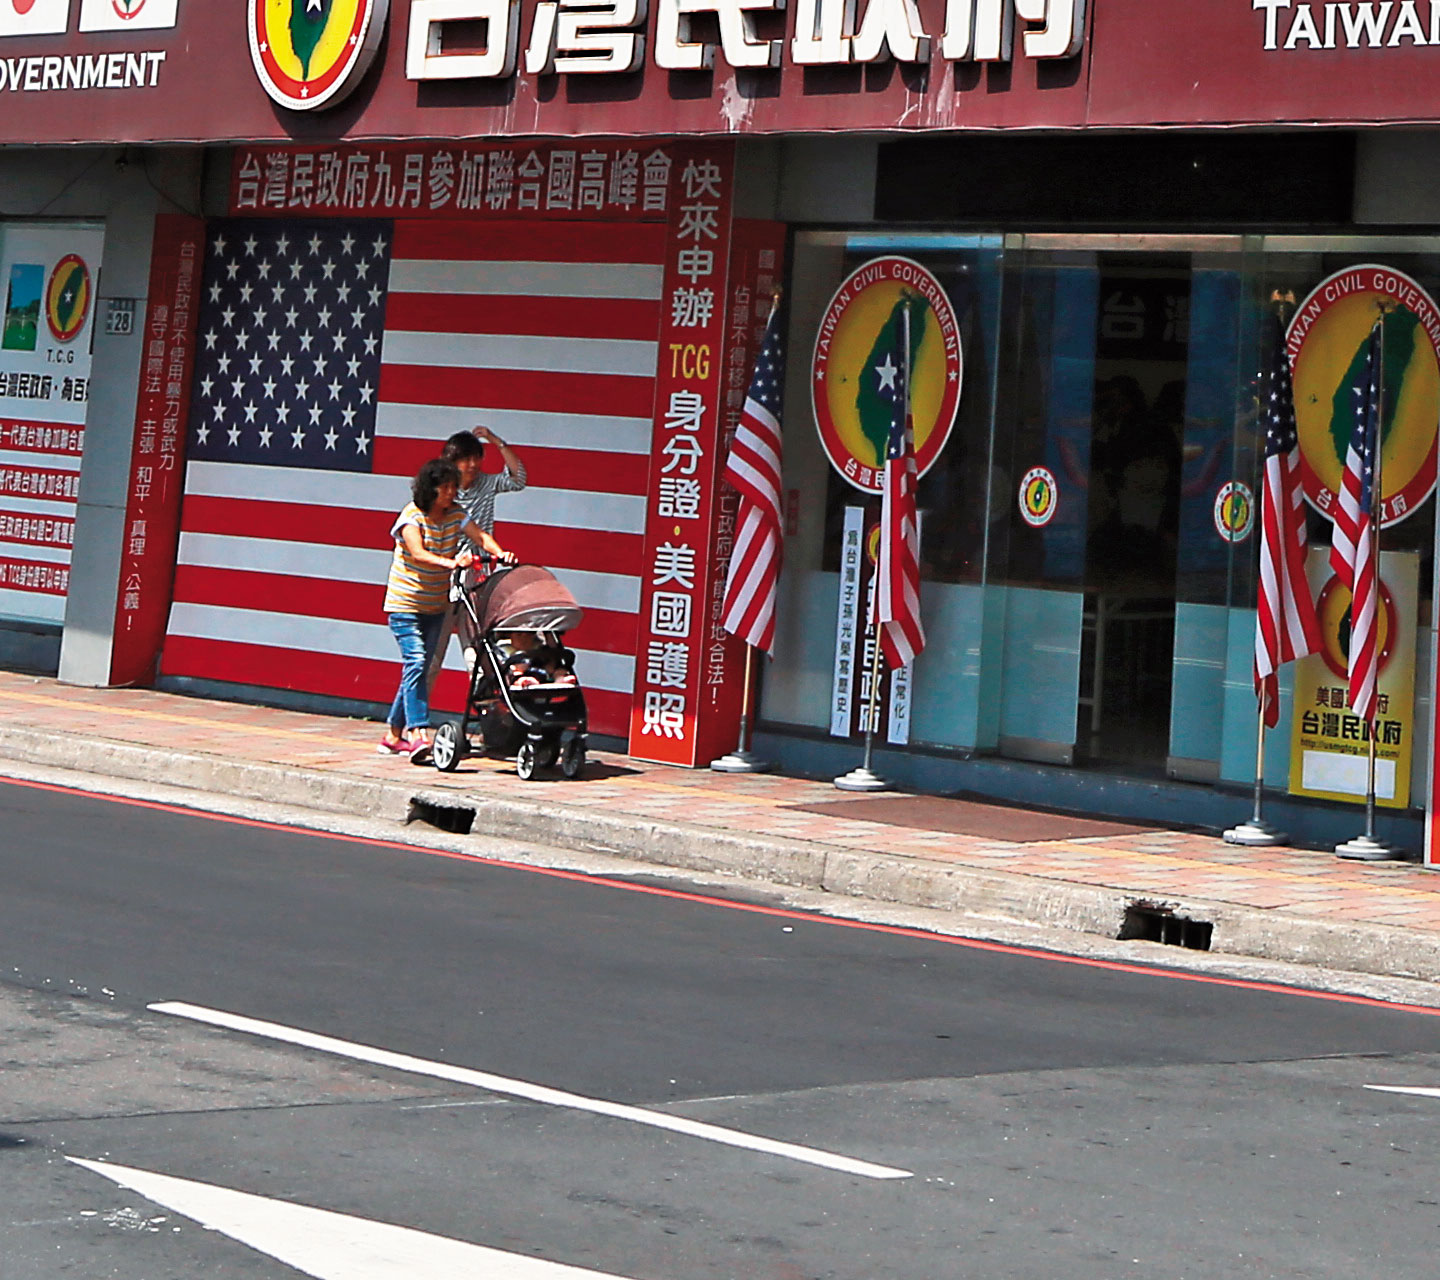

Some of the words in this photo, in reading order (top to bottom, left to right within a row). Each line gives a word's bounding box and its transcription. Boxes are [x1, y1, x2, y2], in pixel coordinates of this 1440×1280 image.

[236, 149, 673, 212] 台灣民政府九月參加聯合國高峰會
[115, 312, 130, 331] 28
[817, 290, 850, 361] TAIWAN
[853, 265, 887, 291] CIVIL
[892, 263, 958, 362] GOVERNMENT
[1288, 301, 1322, 368] AIWAN
[1325, 273, 1365, 302] CIVIL
[669, 343, 709, 380] TCG
[844, 458, 885, 488] 台灣民
